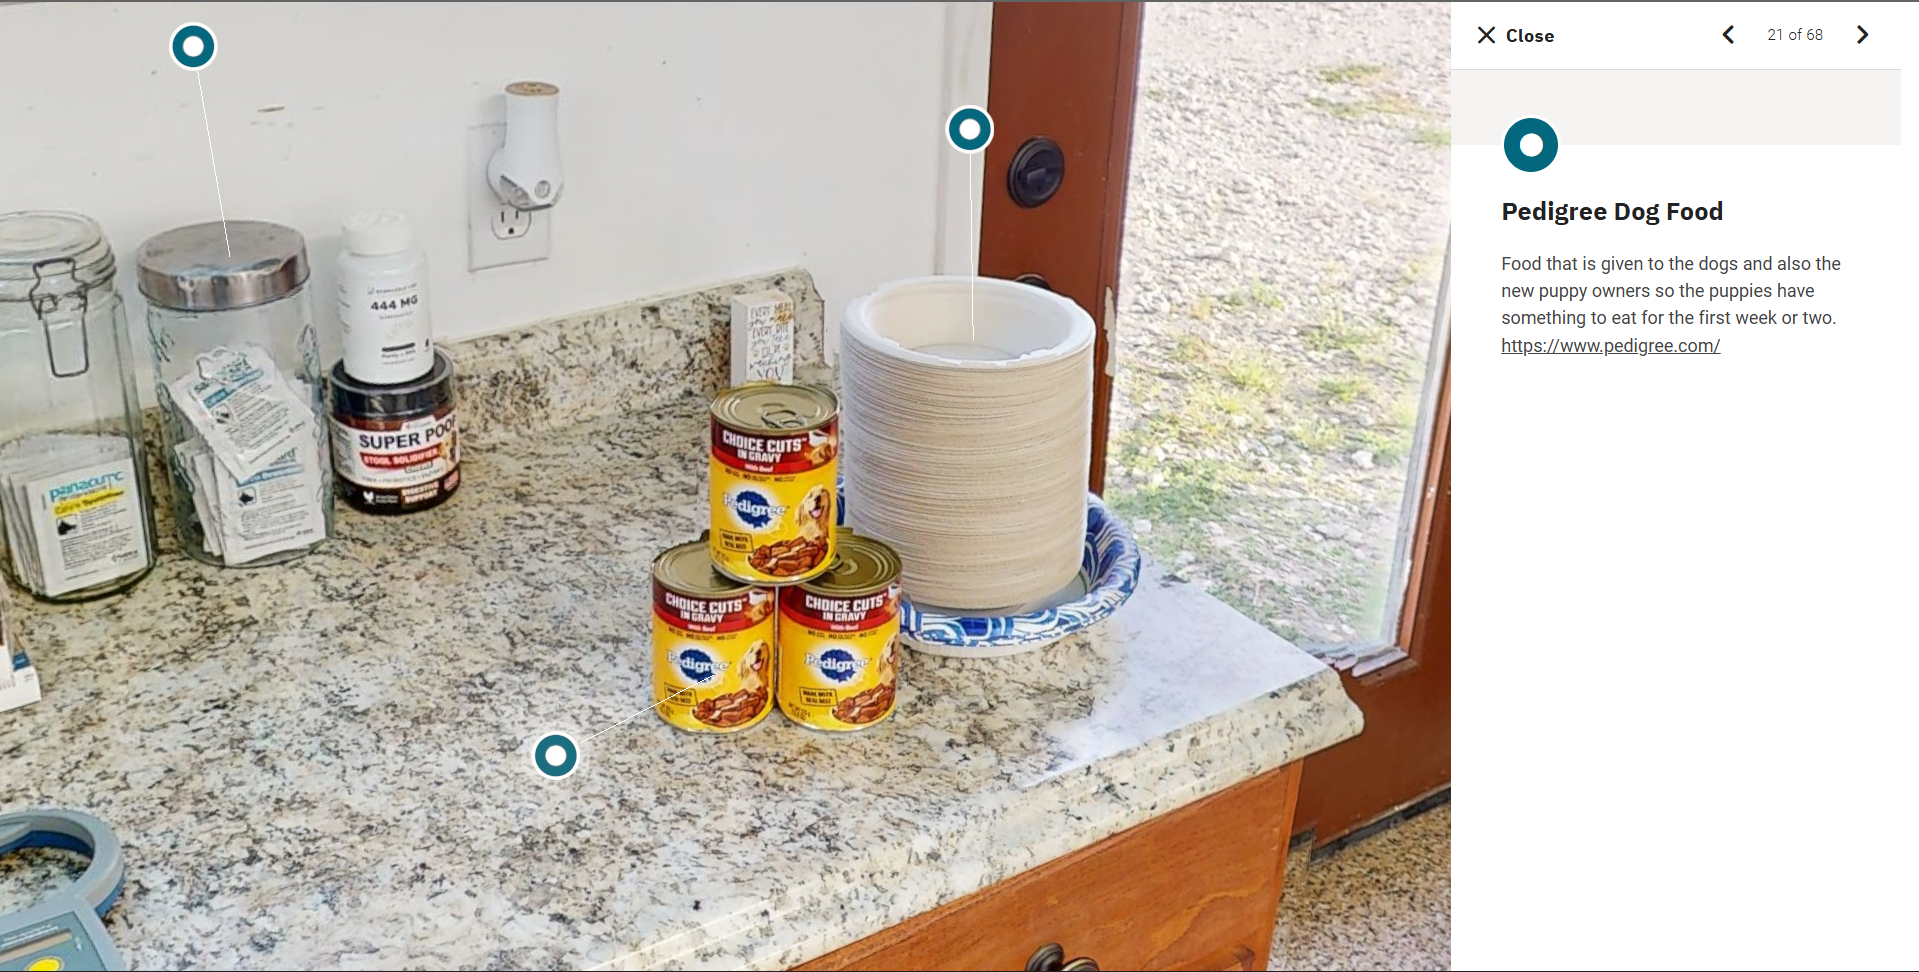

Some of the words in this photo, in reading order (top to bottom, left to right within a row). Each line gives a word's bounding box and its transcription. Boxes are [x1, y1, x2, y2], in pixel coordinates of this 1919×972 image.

[371, 300, 397, 310] 444
[400, 294, 418, 308] MG
[757, 366, 784, 380] YOU
[359, 432, 421, 449] SUPER
[722, 429, 765, 452] CHOICE
[766, 438, 802, 453] CUTS
[737, 448, 748, 460] IN
[748, 452, 782, 464] GRAVY
[723, 492, 786, 517] Pedigree
[665, 592, 707, 613] CHOICE
[709, 599, 743, 614] CUTS
[805, 594, 851, 612] CHOICE
[853, 595, 884, 611] CUTS
[680, 610, 691, 620] IN
[691, 613, 724, 623] GRAVY
[823, 611, 833, 620] IN
[834, 611, 867, 622] GRAVY
[668, 649, 729, 674] Pedigree
[805, 652, 869, 673] Pedigree
